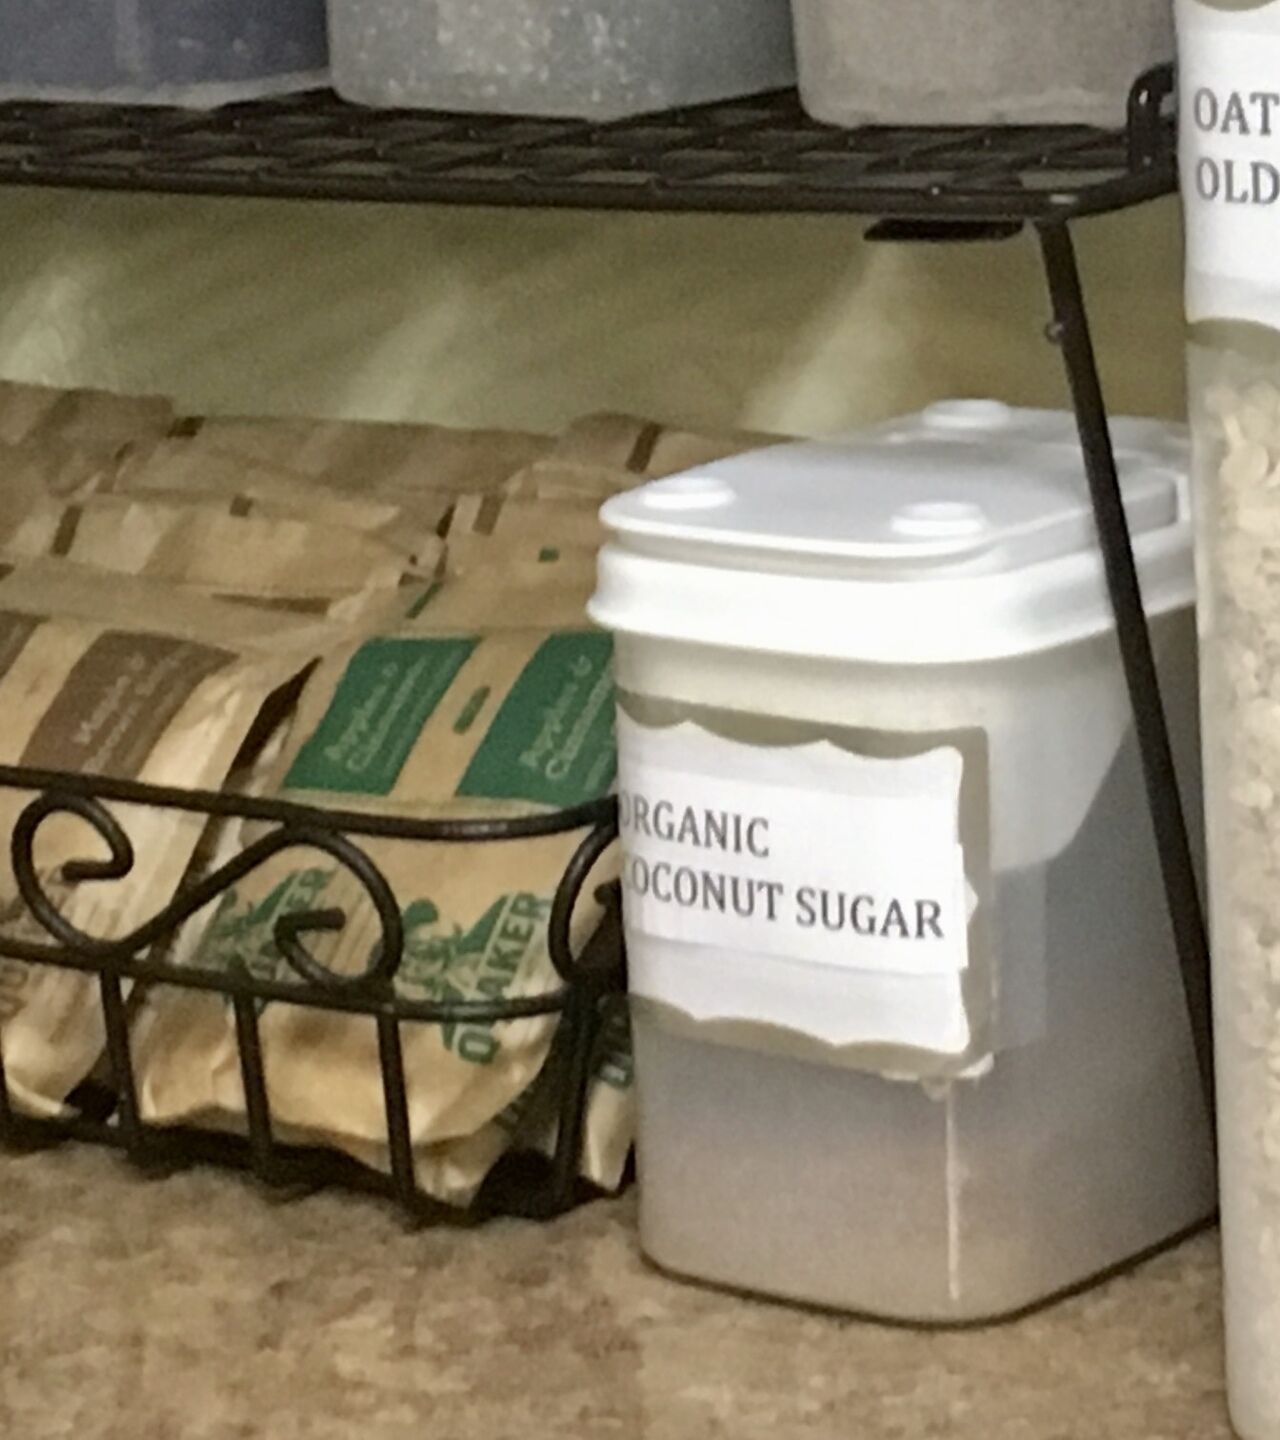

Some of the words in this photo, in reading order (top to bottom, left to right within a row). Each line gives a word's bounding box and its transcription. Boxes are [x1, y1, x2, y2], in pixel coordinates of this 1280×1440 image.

[1195, 158, 1280, 205] OLD
[795, 888, 945, 940] SUGAR
[454, 892, 550, 1064] QAKER
